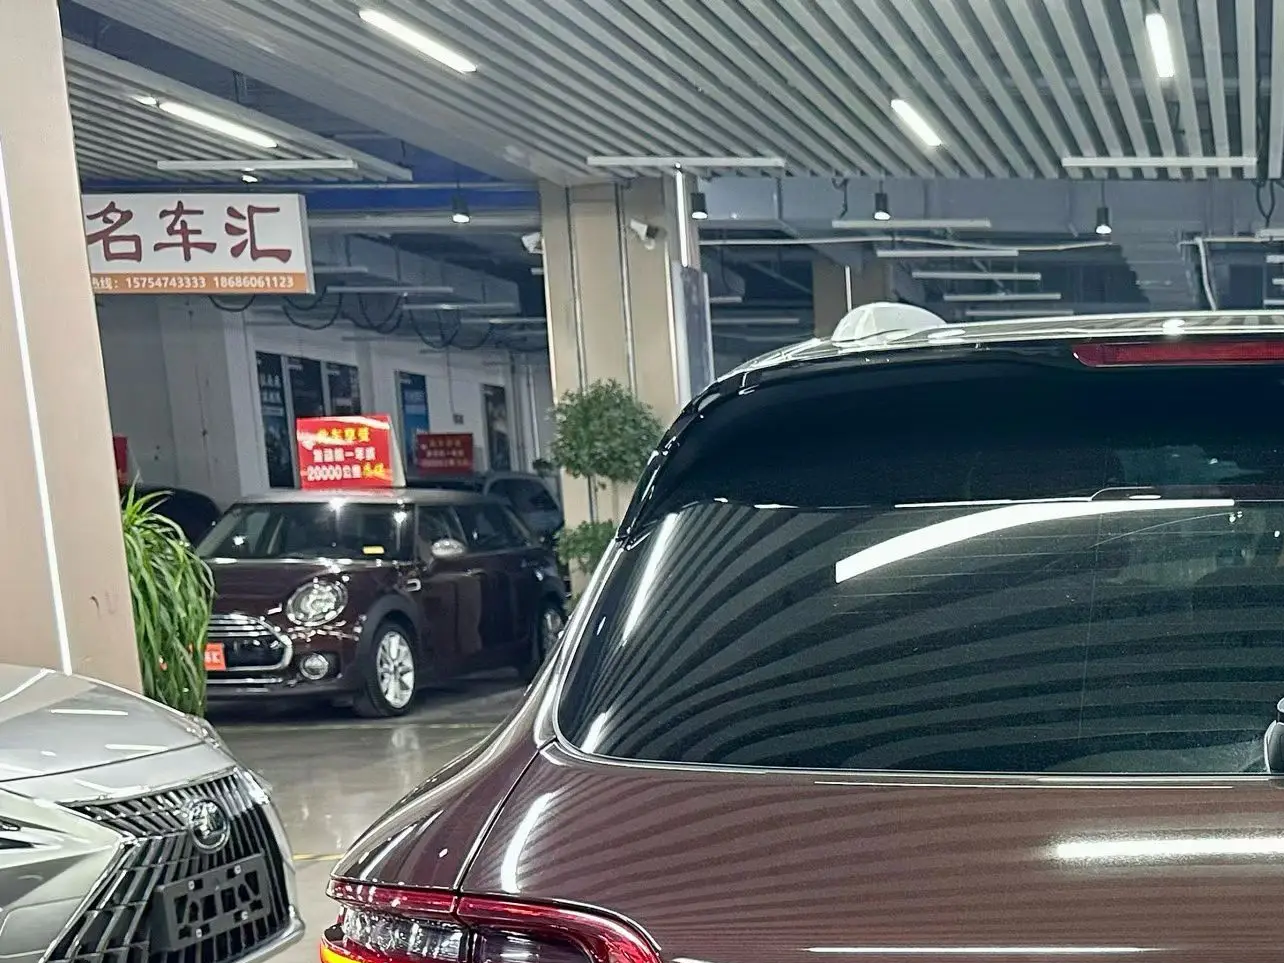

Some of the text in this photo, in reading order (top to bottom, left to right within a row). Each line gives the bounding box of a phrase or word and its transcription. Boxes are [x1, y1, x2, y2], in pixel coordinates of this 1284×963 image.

[86, 201, 292, 263] 名车汇
[125, 276, 206, 289] 15754743333
[213, 276, 294, 288] 18686061123
